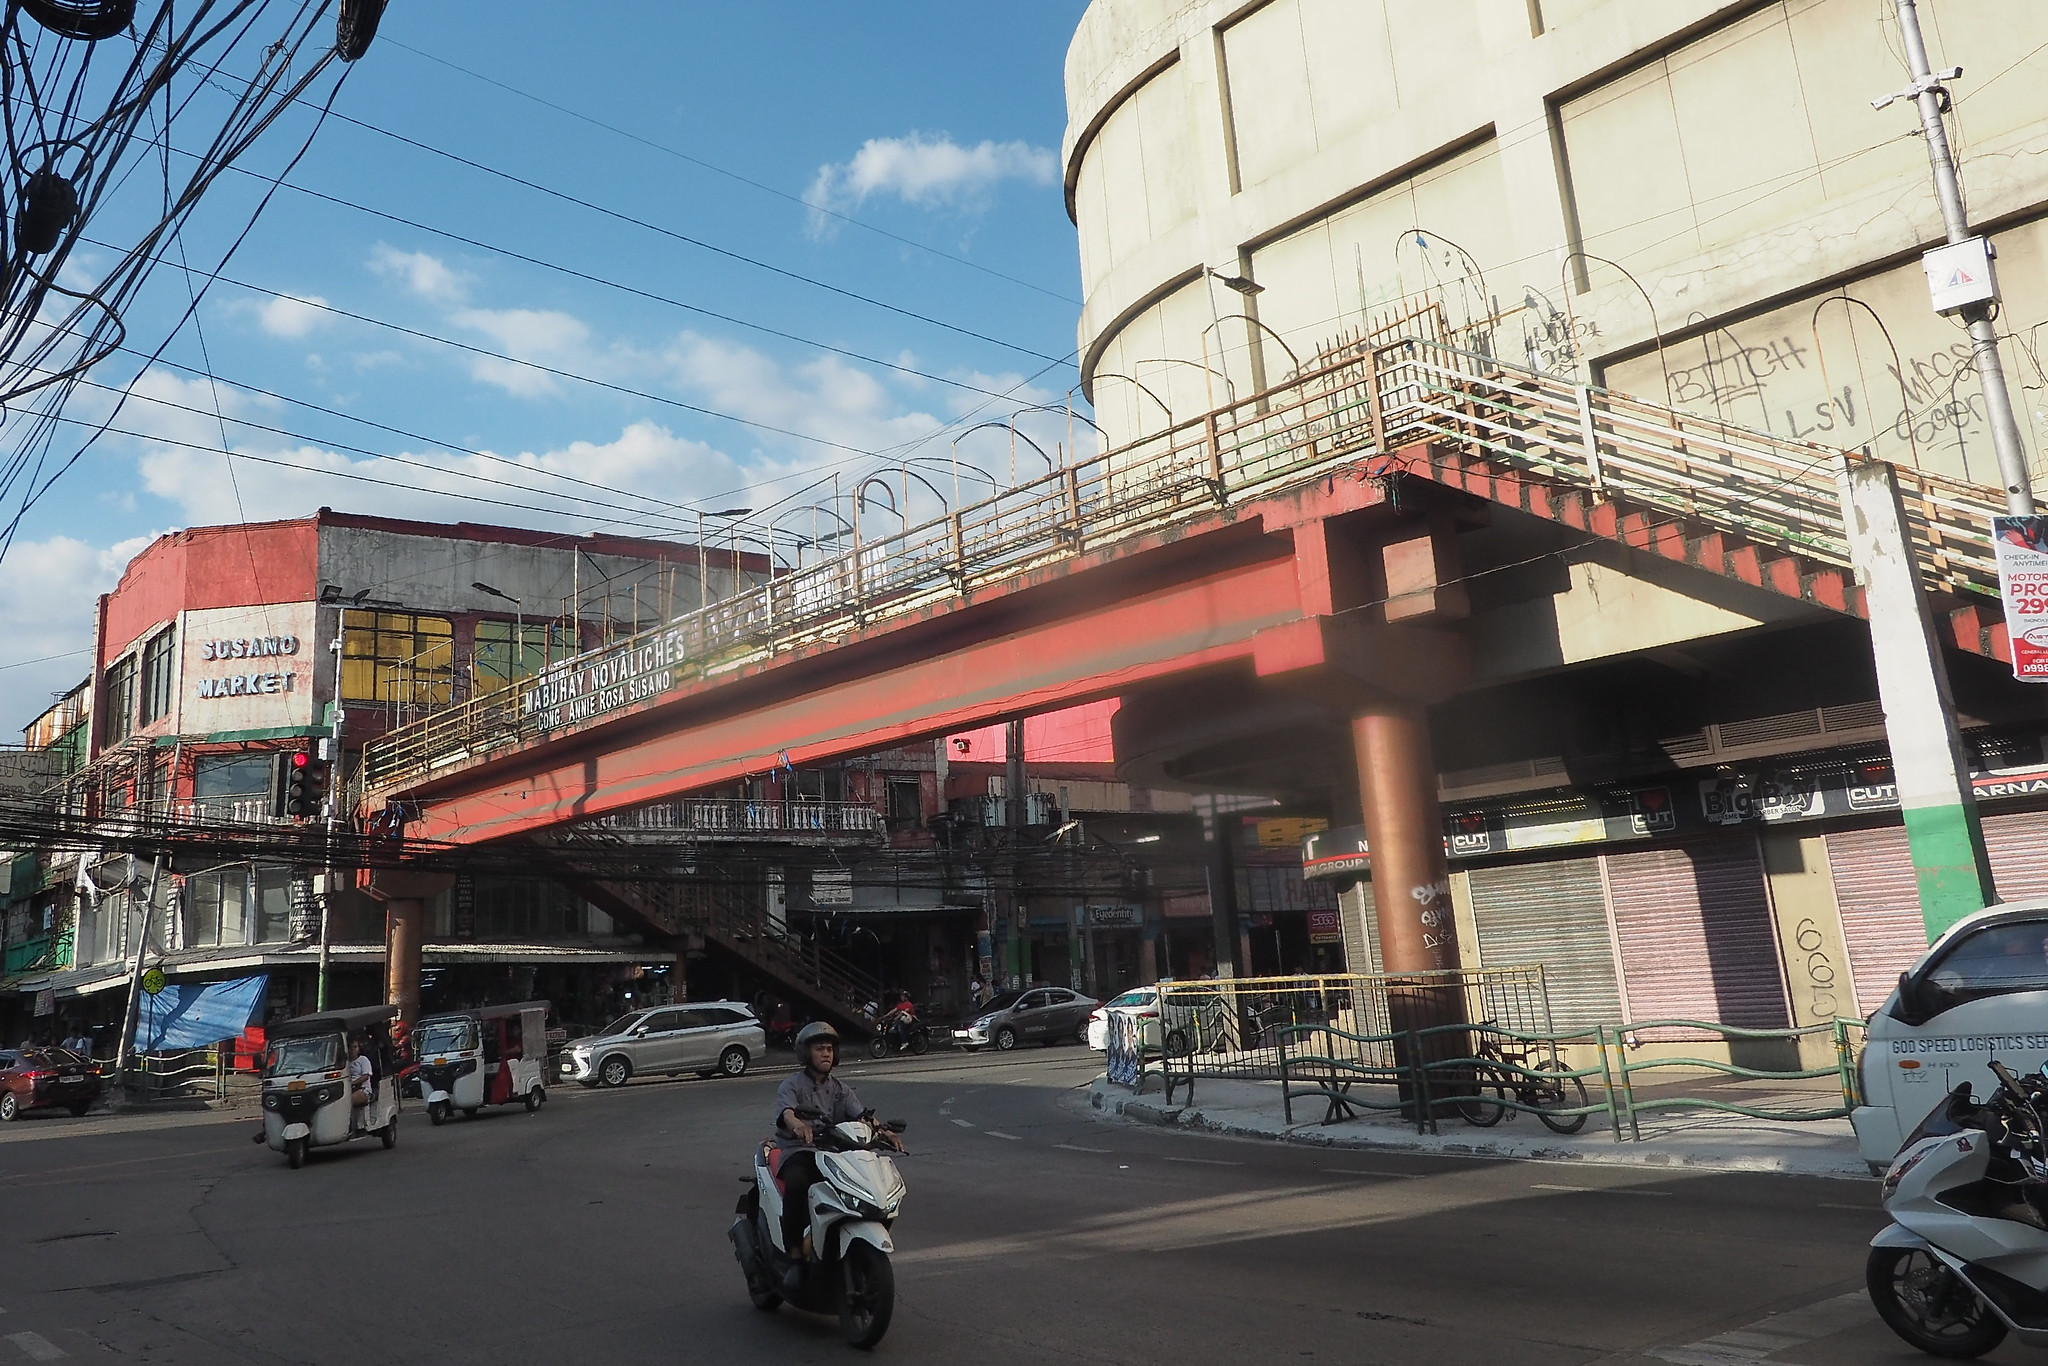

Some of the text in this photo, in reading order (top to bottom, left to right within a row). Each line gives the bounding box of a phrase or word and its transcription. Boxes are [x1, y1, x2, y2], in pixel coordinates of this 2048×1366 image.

[2016, 597, 2048, 614] 29
[201, 634, 297, 661] SUSANO
[525, 671, 585, 714] MABUHAY
[591, 635, 685, 690] NOVALICHES
[198, 671, 294, 698] MARKET
[537, 670, 670, 731] CONG. ANNIE ROSA SUSANO
[1850, 784, 1896, 801] CUT
[1705, 788, 1754, 819] Big
[1634, 811, 1671, 826] CUT
[1455, 833, 1486, 847] CUT
[1319, 858, 1364, 871] GROUP
[1892, 1040, 1916, 1054] GOD
[1919, 1038, 1957, 1053] SPEED
[1959, 1035, 2023, 1051] LOGISTICS
